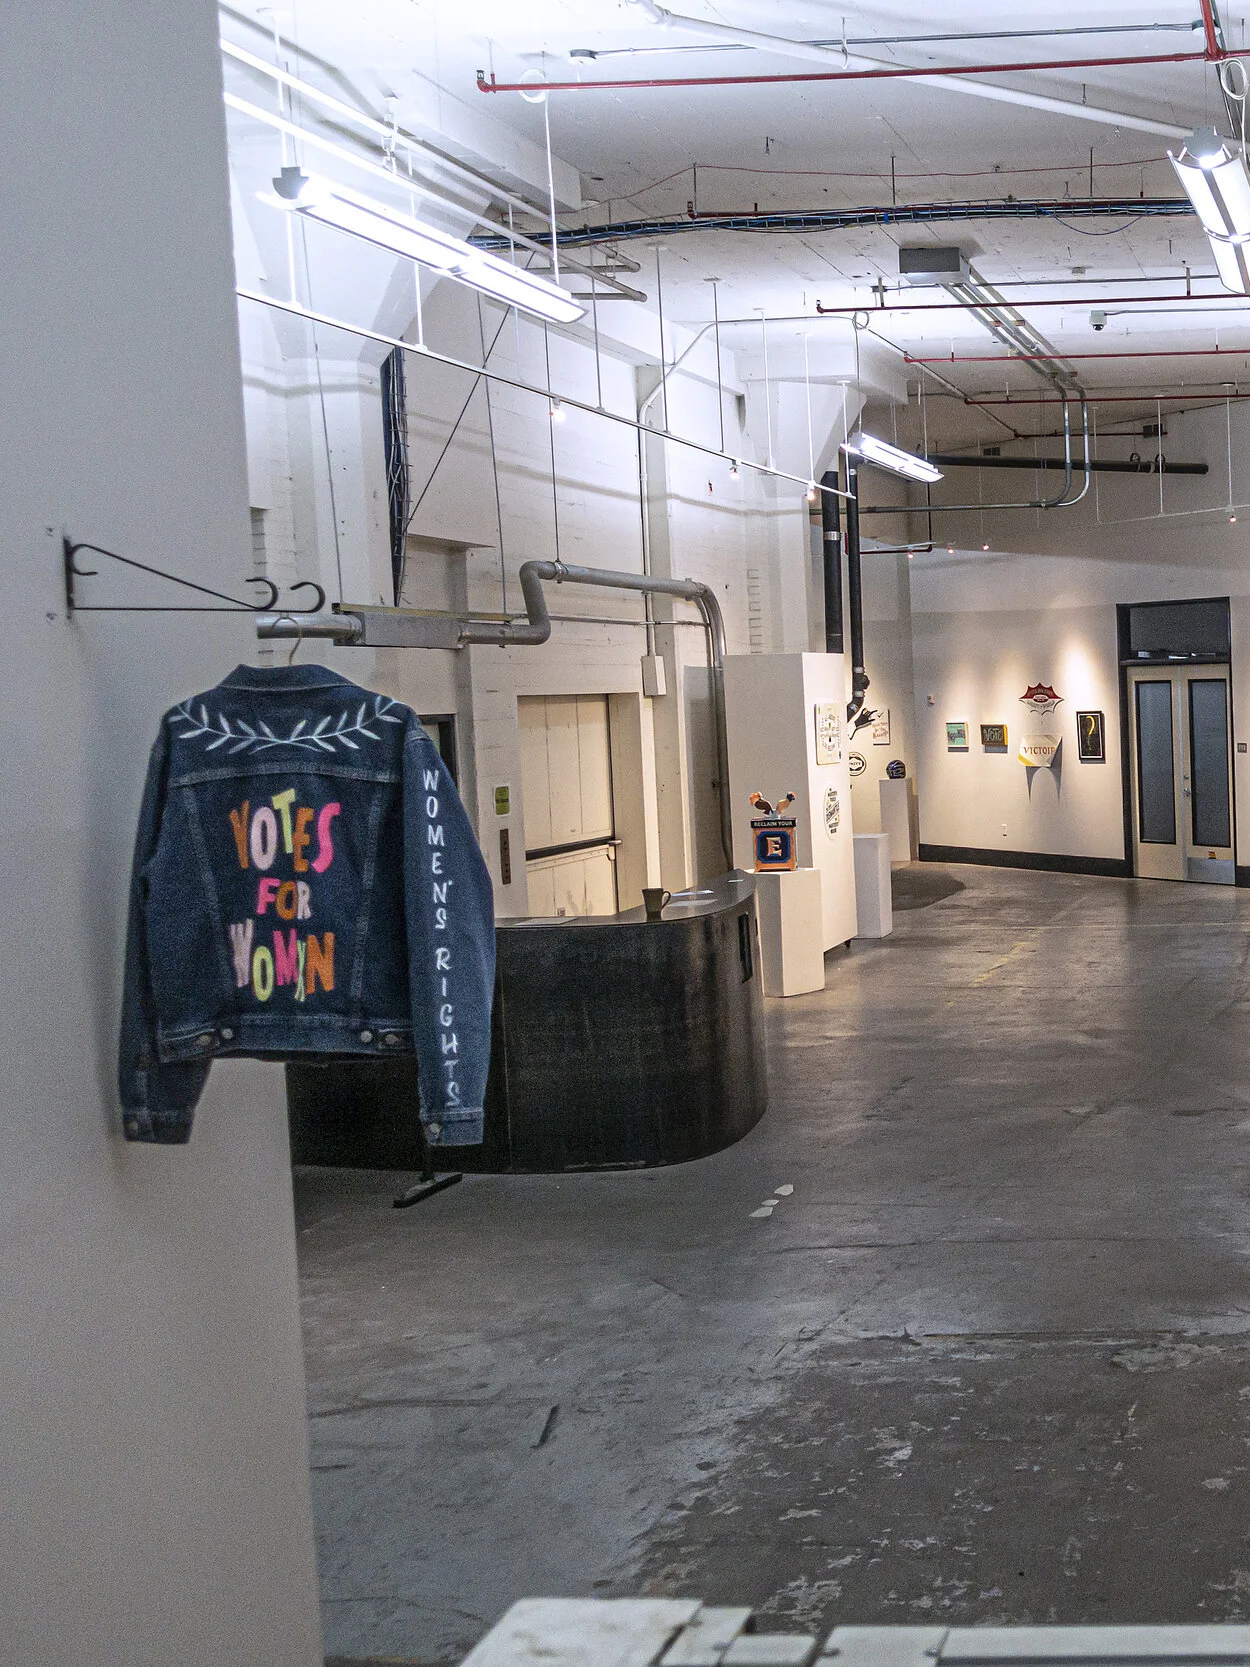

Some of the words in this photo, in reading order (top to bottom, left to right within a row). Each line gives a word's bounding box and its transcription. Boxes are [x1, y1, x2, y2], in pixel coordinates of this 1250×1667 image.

[229, 788, 341, 874] VOTES
[766, 836, 782, 856] E
[256, 877, 312, 920] FOR
[435, 947, 460, 1107] RIGHTS
